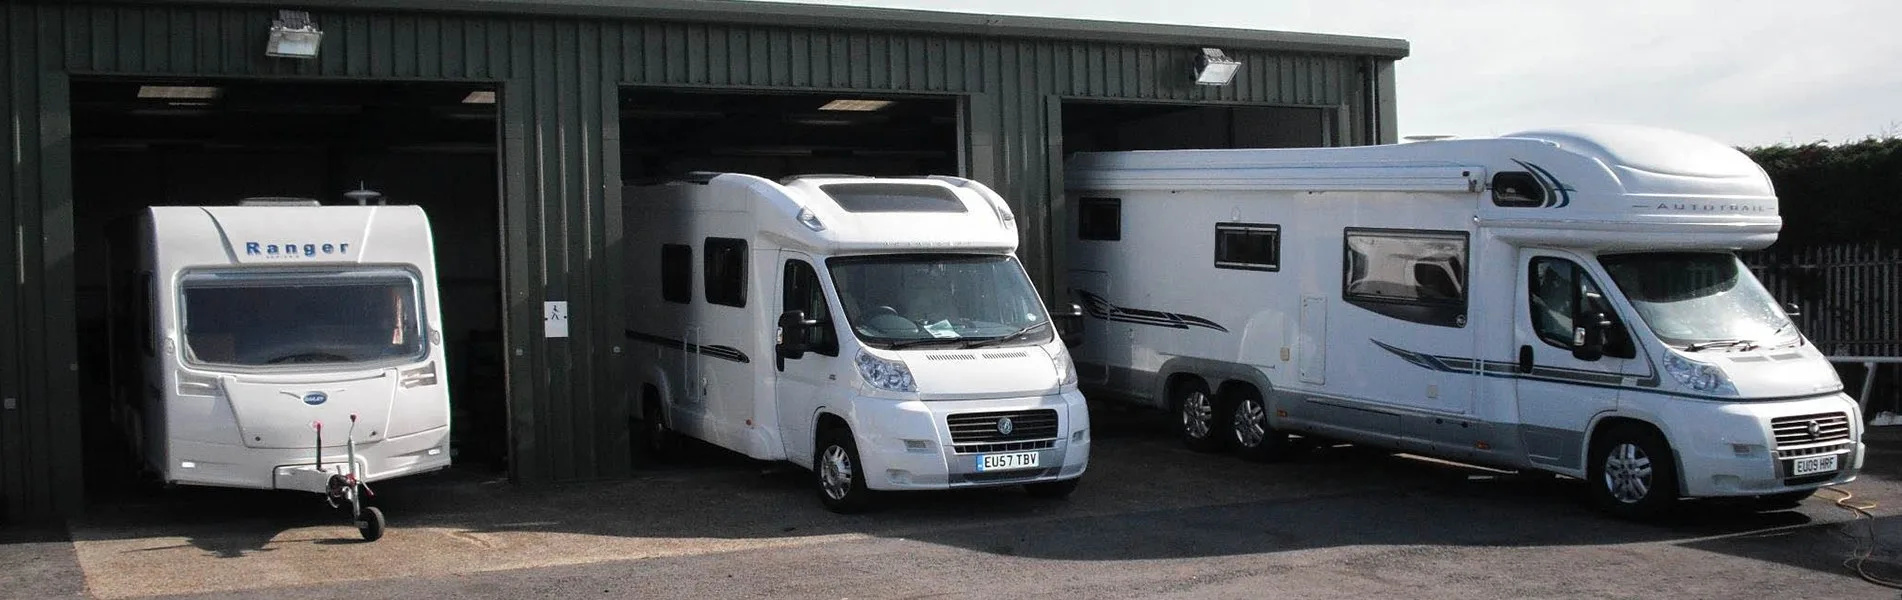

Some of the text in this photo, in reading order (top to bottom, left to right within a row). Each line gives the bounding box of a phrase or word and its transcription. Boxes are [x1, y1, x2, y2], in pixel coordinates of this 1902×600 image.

[1656, 202, 1766, 213] AUTOTRAIL
[246, 241, 349, 257] Ranger
[984, 453, 1036, 468] EU57 TBV
[1797, 456, 1835, 473] EU09 HRF
